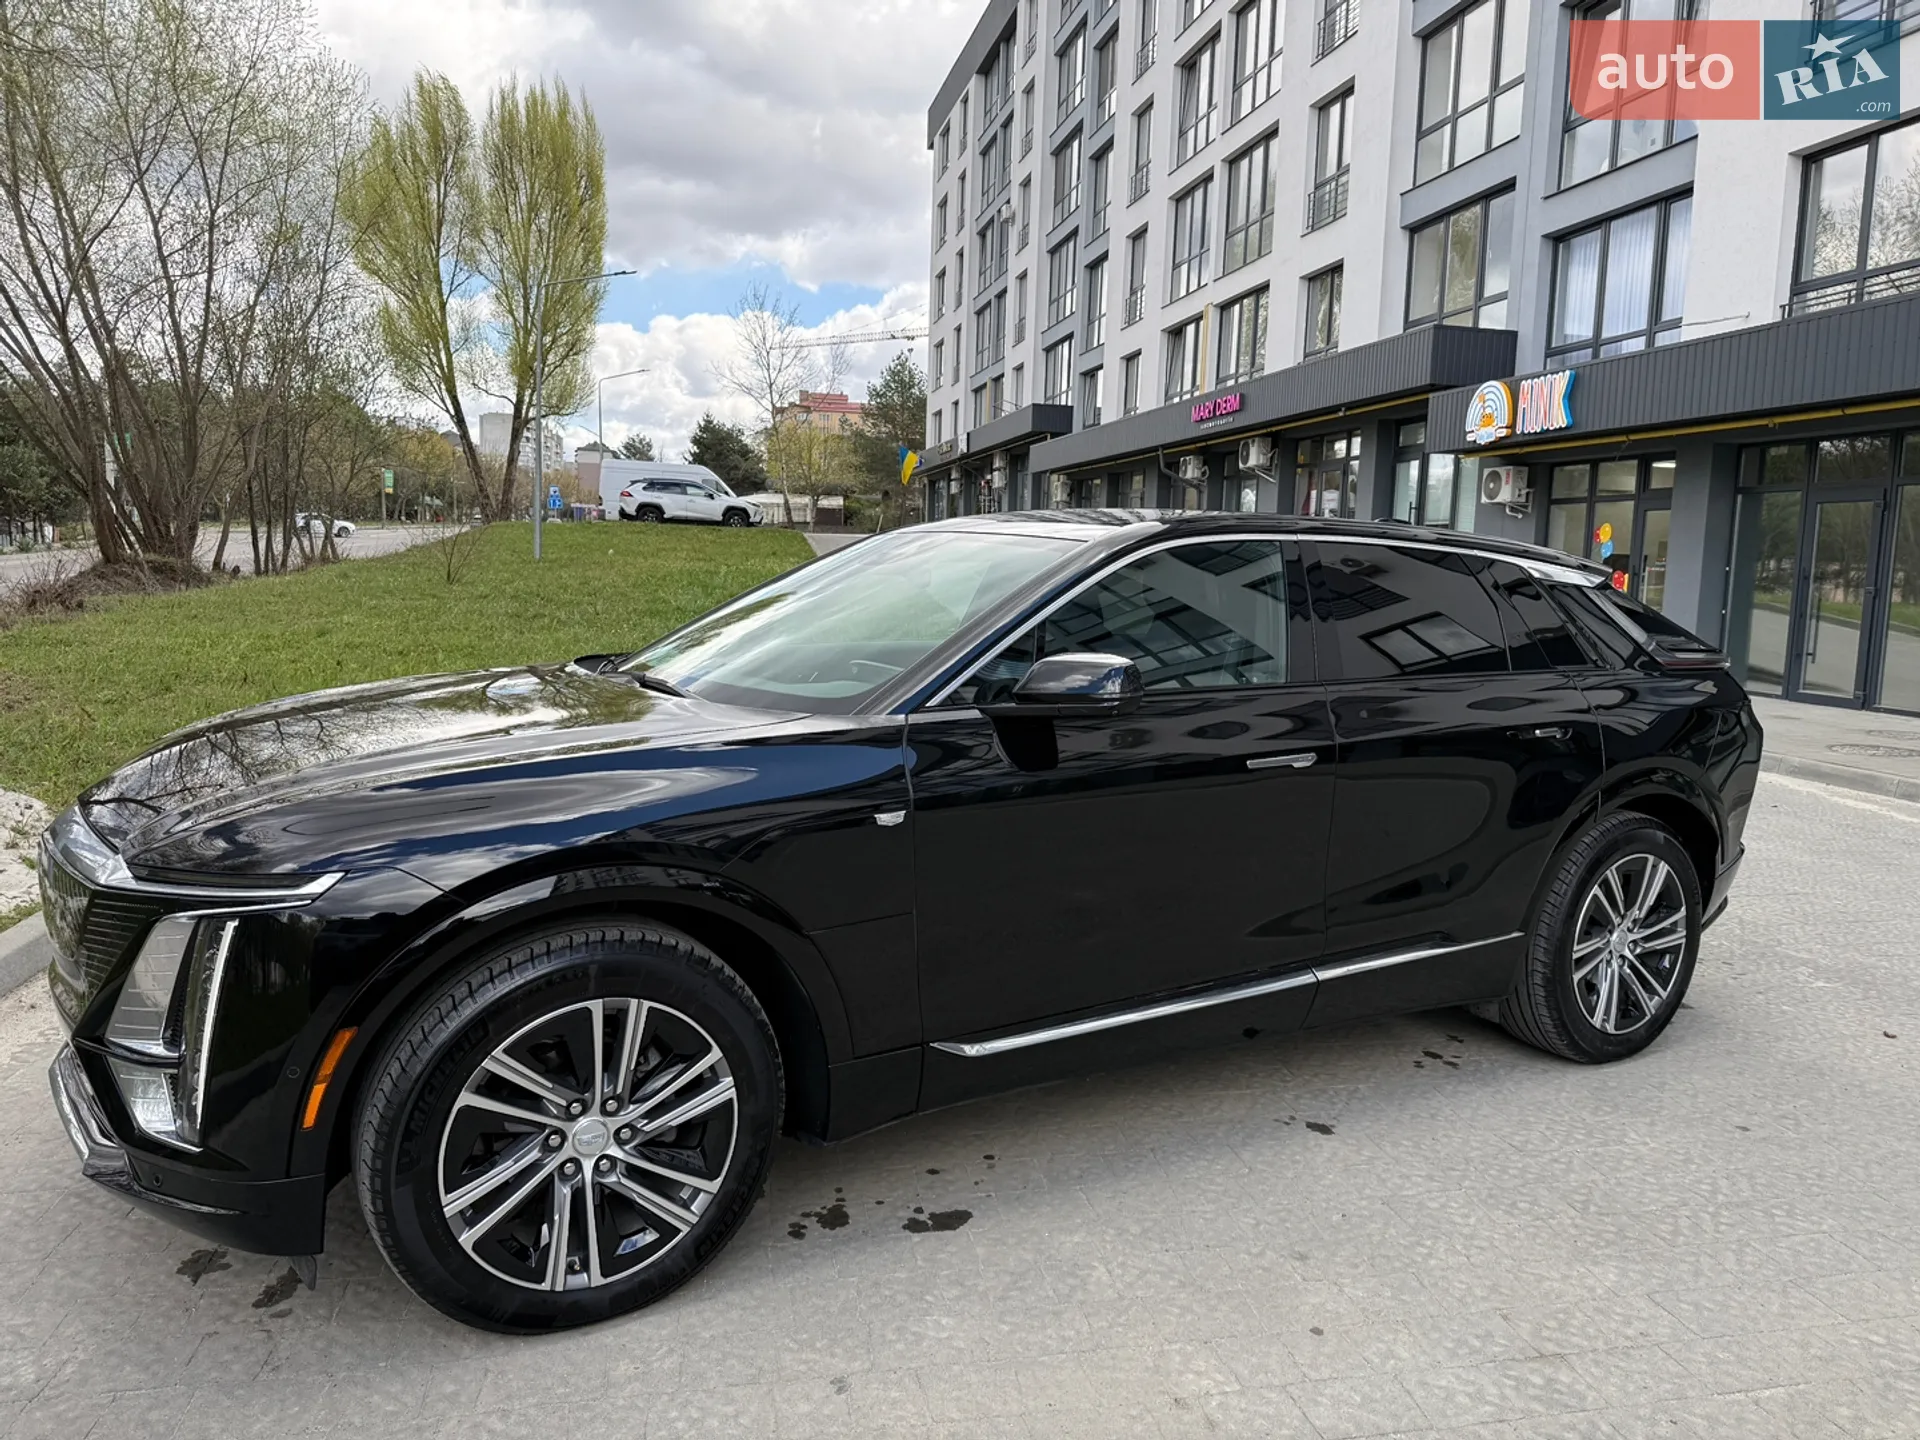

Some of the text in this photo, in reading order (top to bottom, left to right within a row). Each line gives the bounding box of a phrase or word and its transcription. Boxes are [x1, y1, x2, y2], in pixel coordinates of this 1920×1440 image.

[1191, 400, 1216, 423] MARY
[1215, 393, 1242, 416] DERM
[1516, 369, 1573, 434] MINIK
